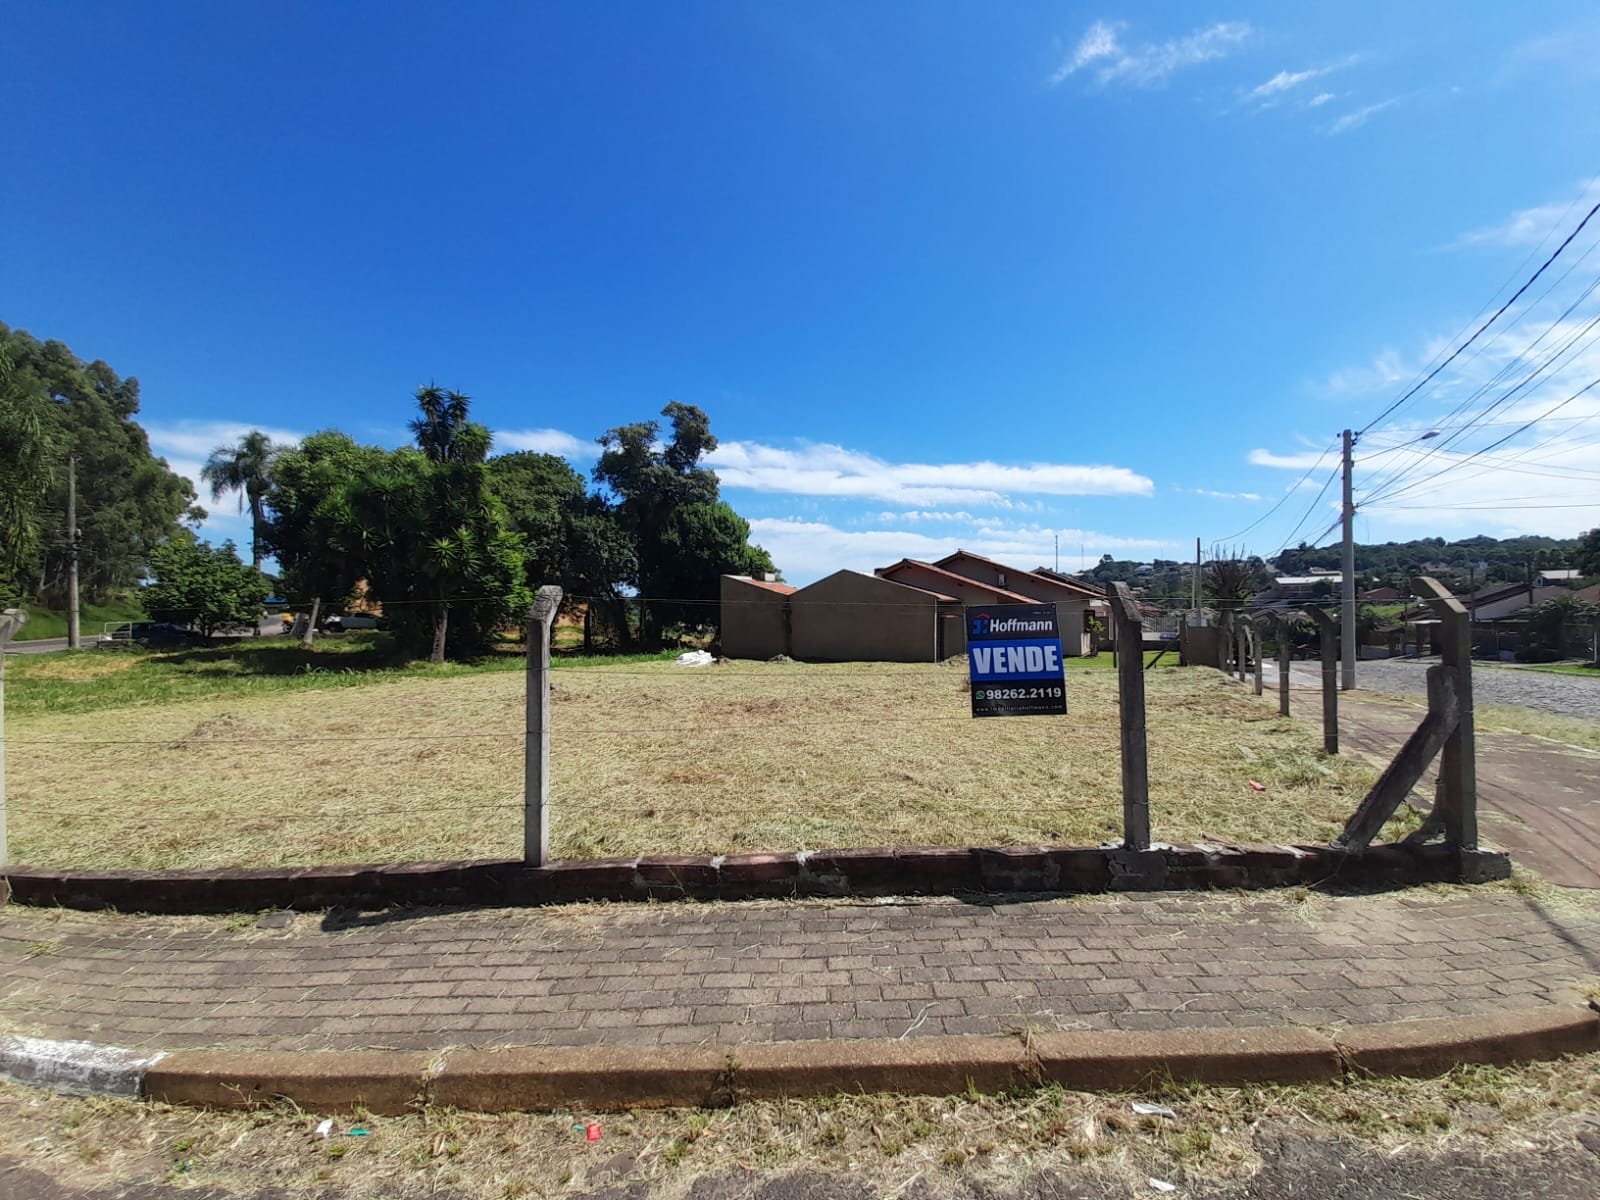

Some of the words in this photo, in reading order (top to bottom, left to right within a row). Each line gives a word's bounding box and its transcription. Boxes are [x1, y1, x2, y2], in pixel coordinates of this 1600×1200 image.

[990, 618, 1053, 632] Hoffmann
[973, 645, 1059, 674] VENDE
[986, 687, 1062, 700] 98262.2119
